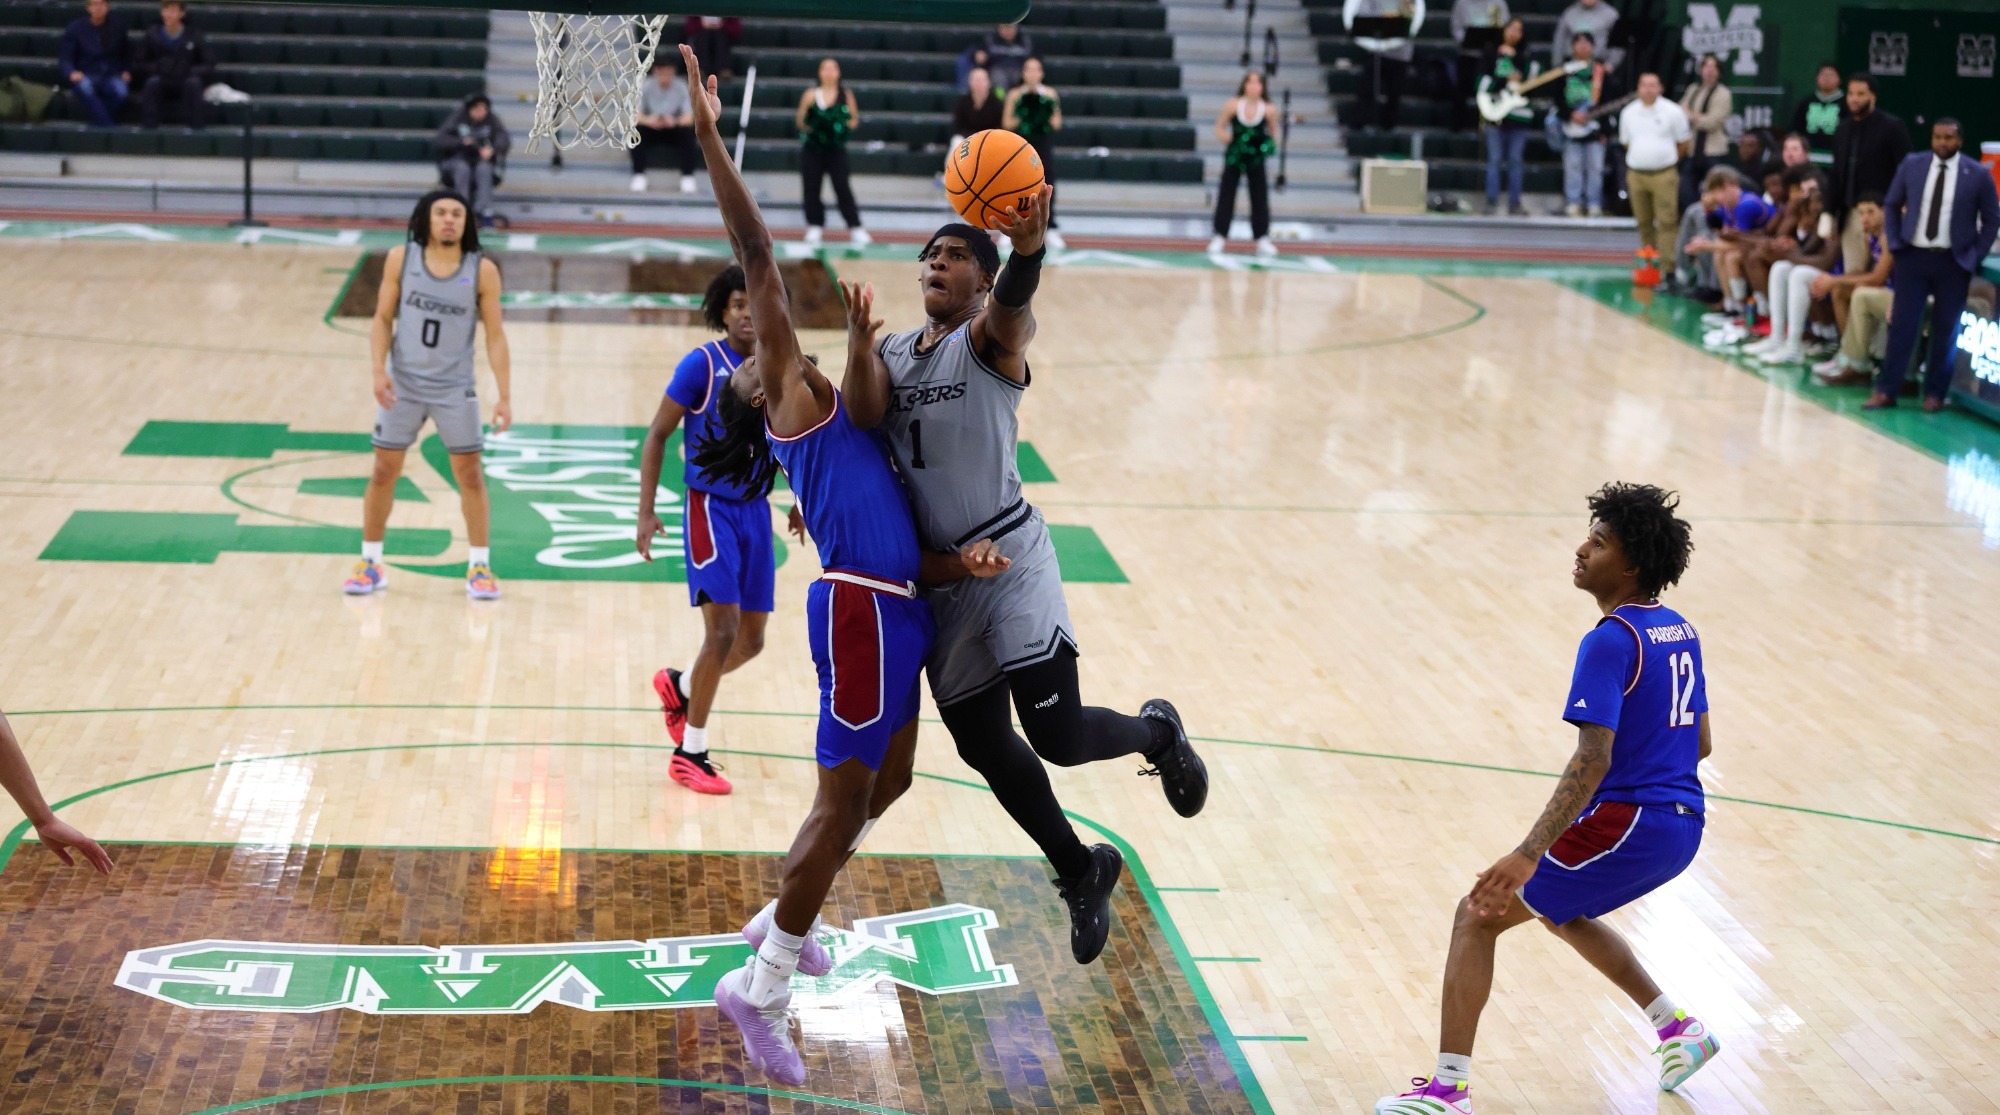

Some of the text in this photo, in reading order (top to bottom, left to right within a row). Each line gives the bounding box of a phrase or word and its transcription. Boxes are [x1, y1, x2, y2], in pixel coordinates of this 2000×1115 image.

[422, 318, 440, 348] 0
[909, 419, 926, 470] 1
[482, 431, 690, 568] JASPERS
[1645, 624, 1687, 645] PARRISH
[1035, 692, 1059, 709] capelli
[1669, 651, 1696, 728] 12
